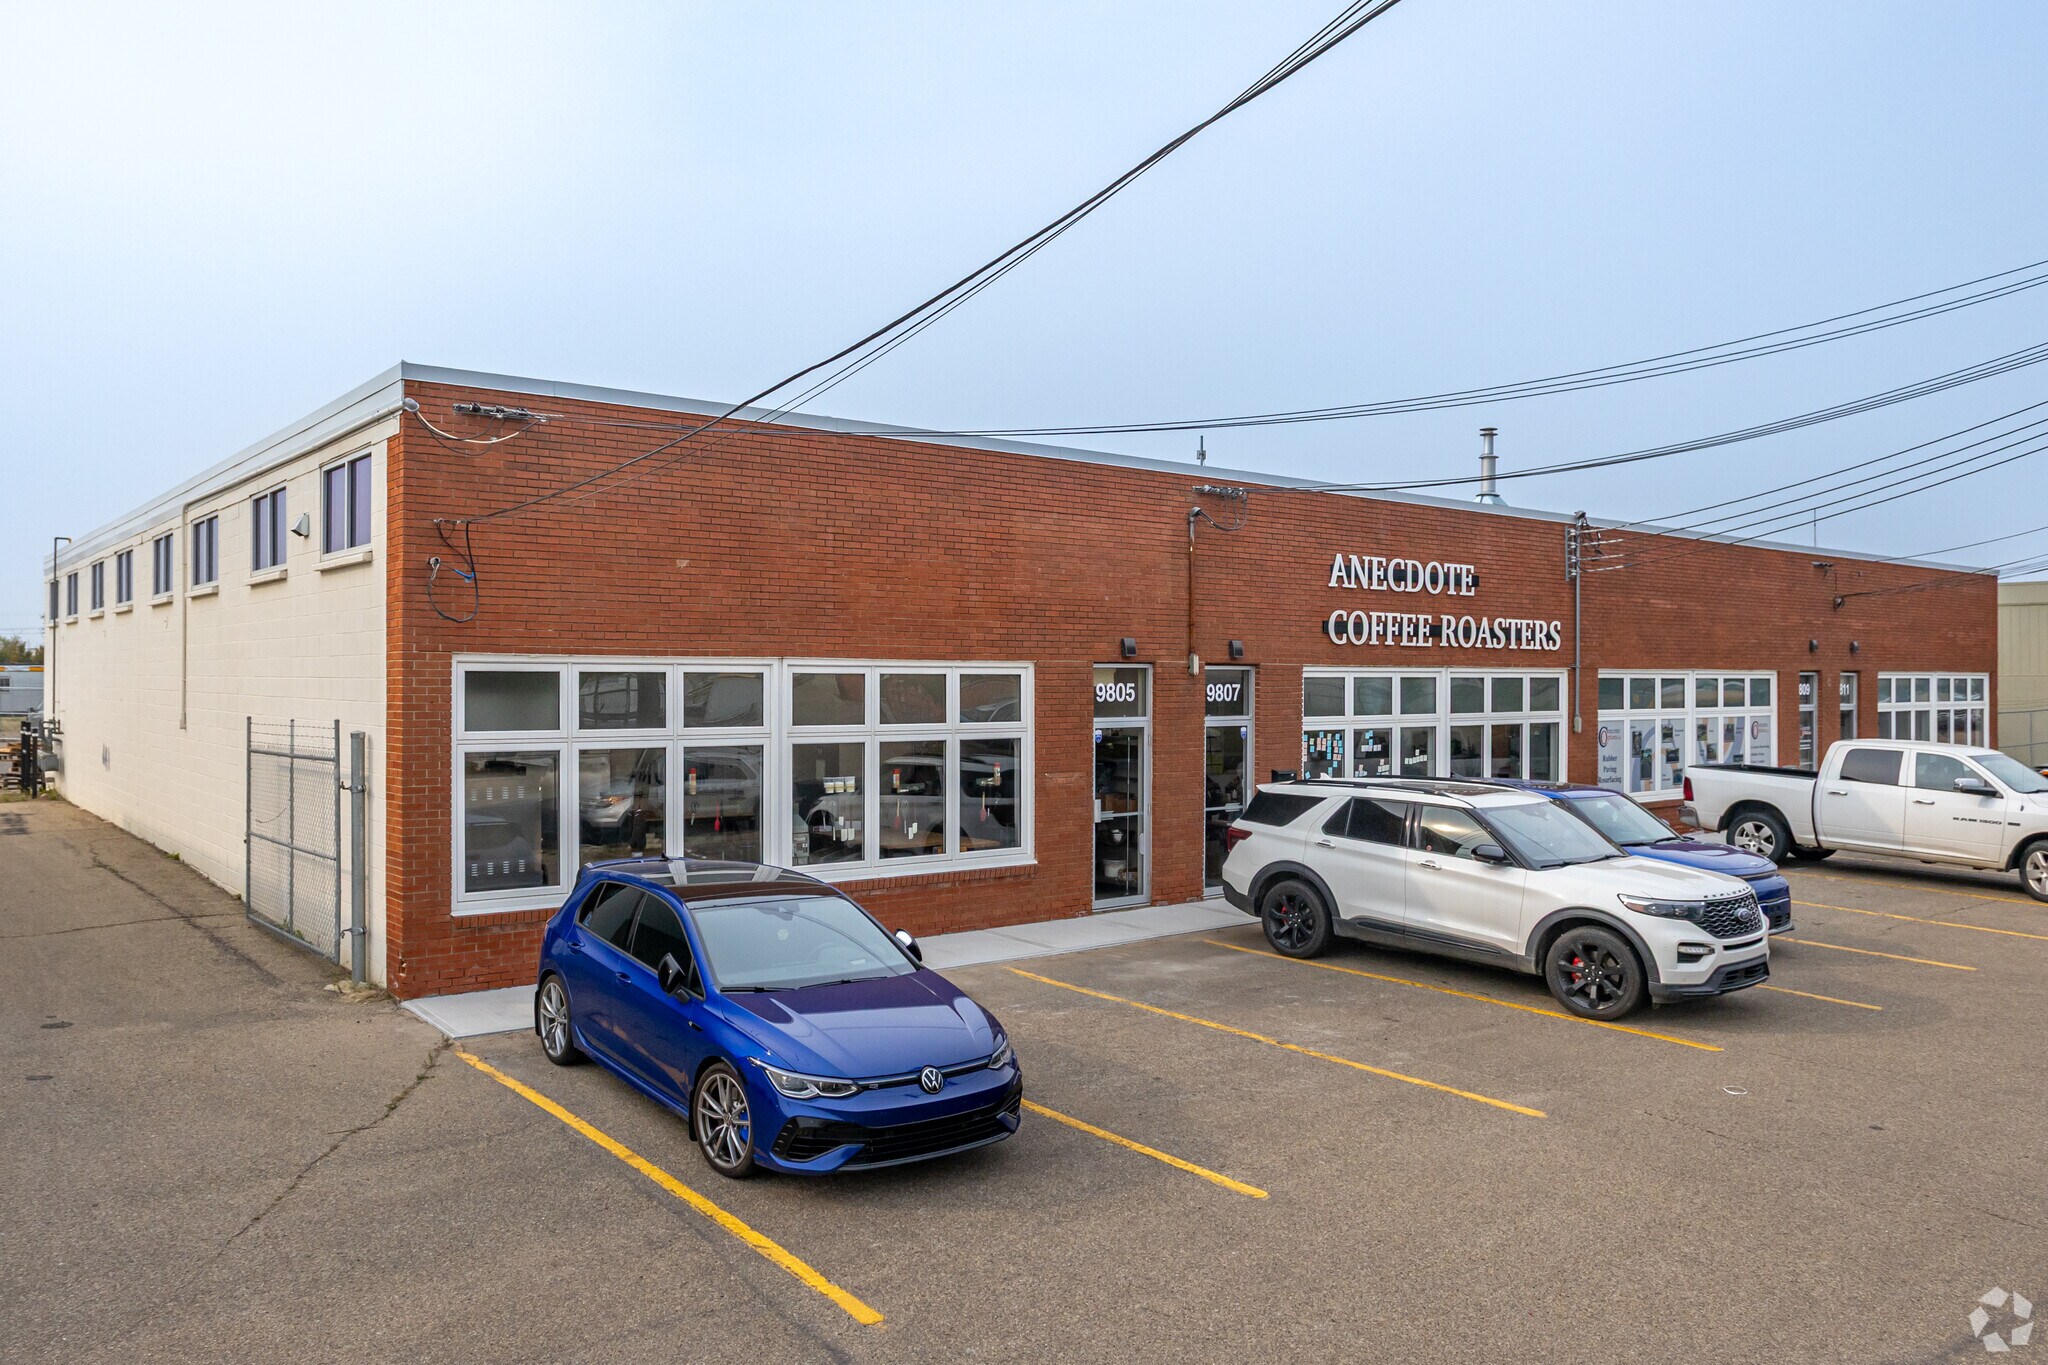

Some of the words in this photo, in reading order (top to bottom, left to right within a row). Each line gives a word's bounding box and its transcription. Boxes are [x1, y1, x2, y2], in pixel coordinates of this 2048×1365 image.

[1328, 553, 1475, 596] ANECDOTE
[1328, 609, 1433, 646] COFFEE
[1440, 614, 1561, 651] ROASTERS
[1096, 682, 1136, 703] 9805
[1206, 683, 1241, 702] 9807
[1602, 754, 1618, 762] Rubber
[1603, 765, 1617, 774] Paving
